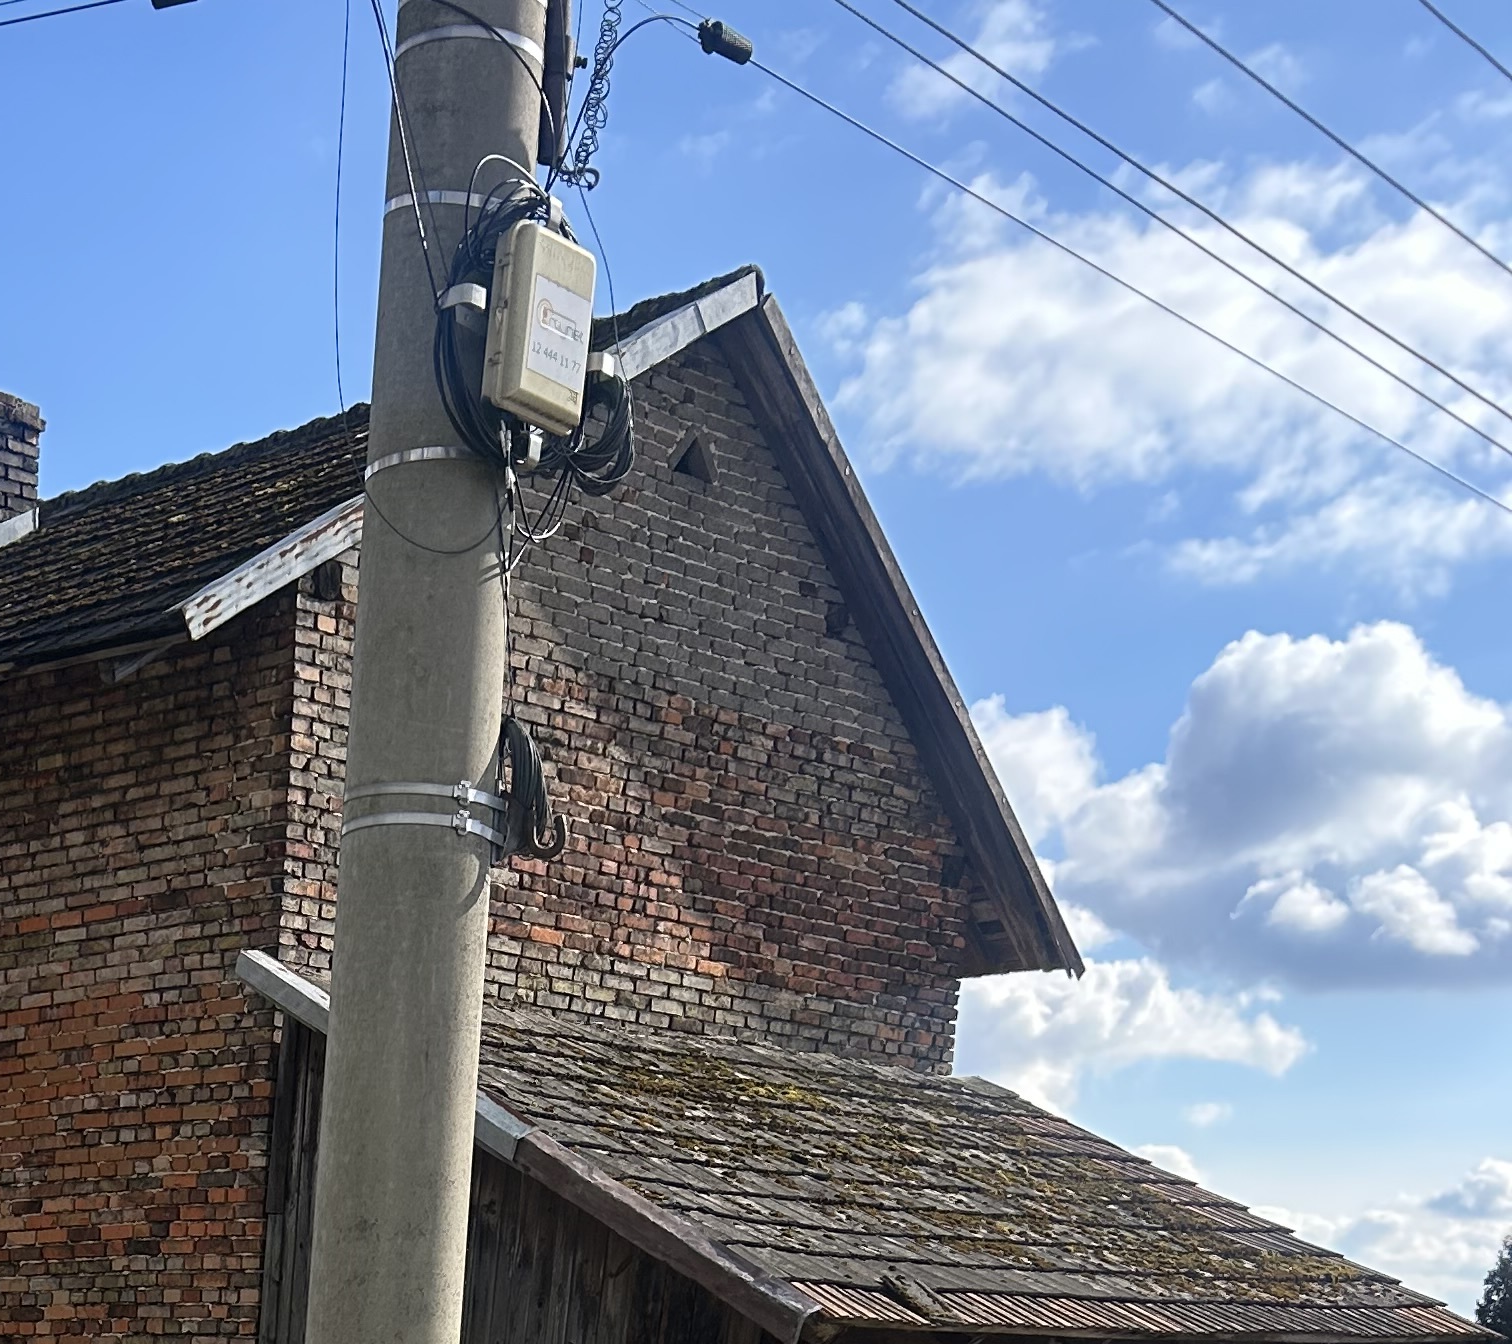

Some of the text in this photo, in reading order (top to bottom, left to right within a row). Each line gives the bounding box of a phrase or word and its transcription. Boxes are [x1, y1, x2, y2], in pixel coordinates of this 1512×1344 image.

[532, 341, 581, 374] 12 444 11 77
